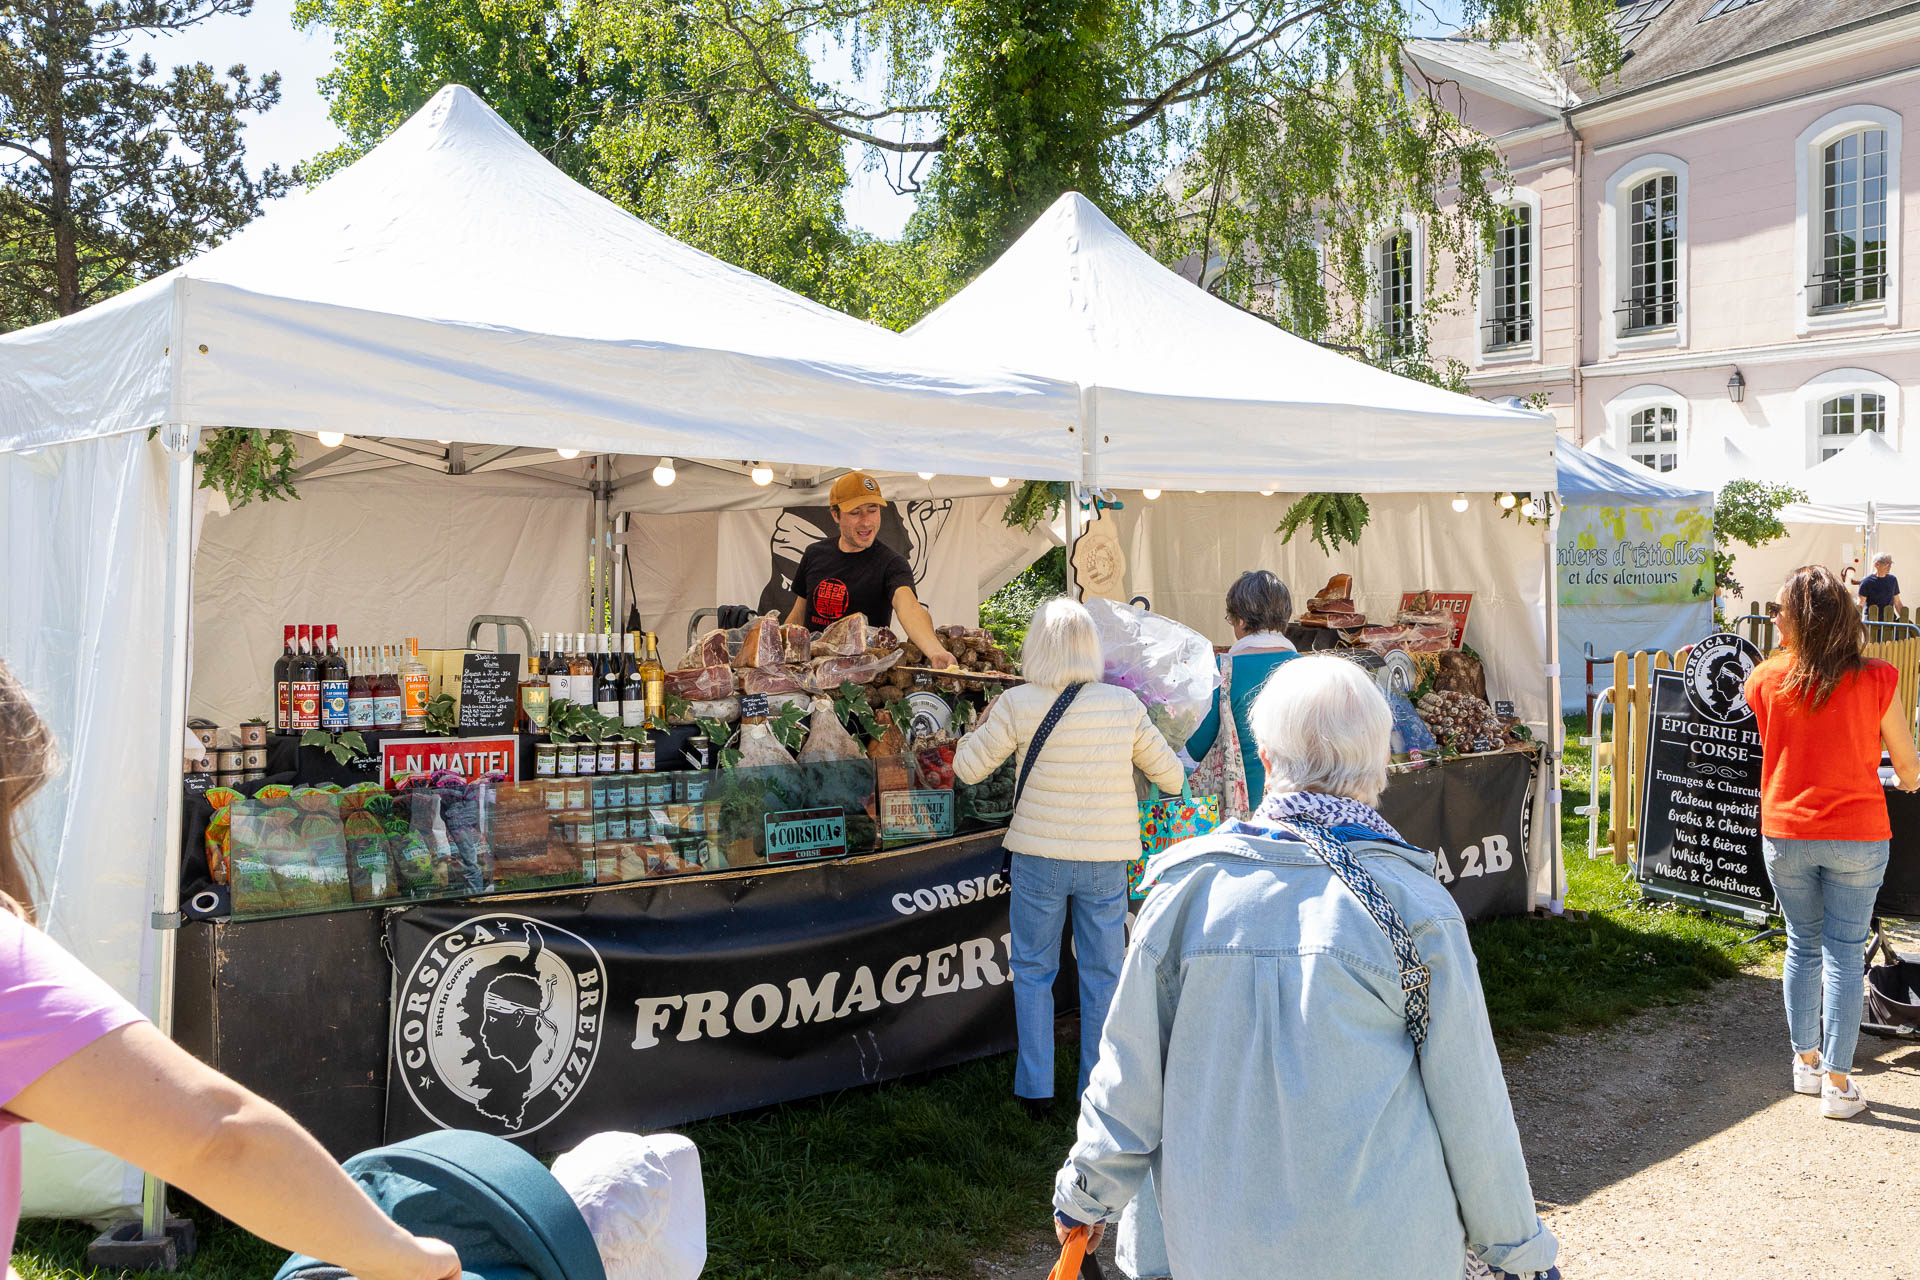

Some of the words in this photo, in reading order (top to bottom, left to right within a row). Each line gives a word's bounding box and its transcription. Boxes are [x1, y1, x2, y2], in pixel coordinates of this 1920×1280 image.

[1568, 571, 1580, 584] et
[1586, 568, 1608, 584] des
[1613, 569, 1678, 584] alentours
[1687, 636, 1724, 687] CORSICA
[1661, 715, 1738, 742] ÉPICERIE
[1741, 730, 1763, 746] FI
[430, 751, 510, 775] MATTEI
[1690, 740, 1748, 761] CORSE
[1656, 769, 1704, 788] Fromages
[1705, 779, 1716, 790] &
[890, 802, 944, 816] BIENVENUE
[910, 813, 942, 826] CORSE
[1670, 790, 1712, 810] Plateau
[1716, 801, 1760, 820] apéritif
[778, 823, 833, 846] CORSICA
[1668, 808, 1702, 827] Brebis
[1705, 815, 1716, 828] &
[1718, 819, 1758, 838] Chèvre
[795, 849, 821, 858] CORSE
[1460, 834, 1513, 878] 2B
[1675, 828, 1698, 845] Vins
[1700, 833, 1710, 847] &
[1713, 836, 1747, 855] Bières
[1672, 846, 1713, 872] Whisky
[1717, 857, 1748, 875] Corse
[1655, 862, 1688, 881] Miels
[1690, 869, 1700, 882] &
[1702, 873, 1762, 897] Confitures
[403, 925, 496, 1069] CORSICA
[434, 1007, 445, 1037] Fattu
[440, 993, 450, 1005] In
[551, 968, 600, 1101] BREIZH
